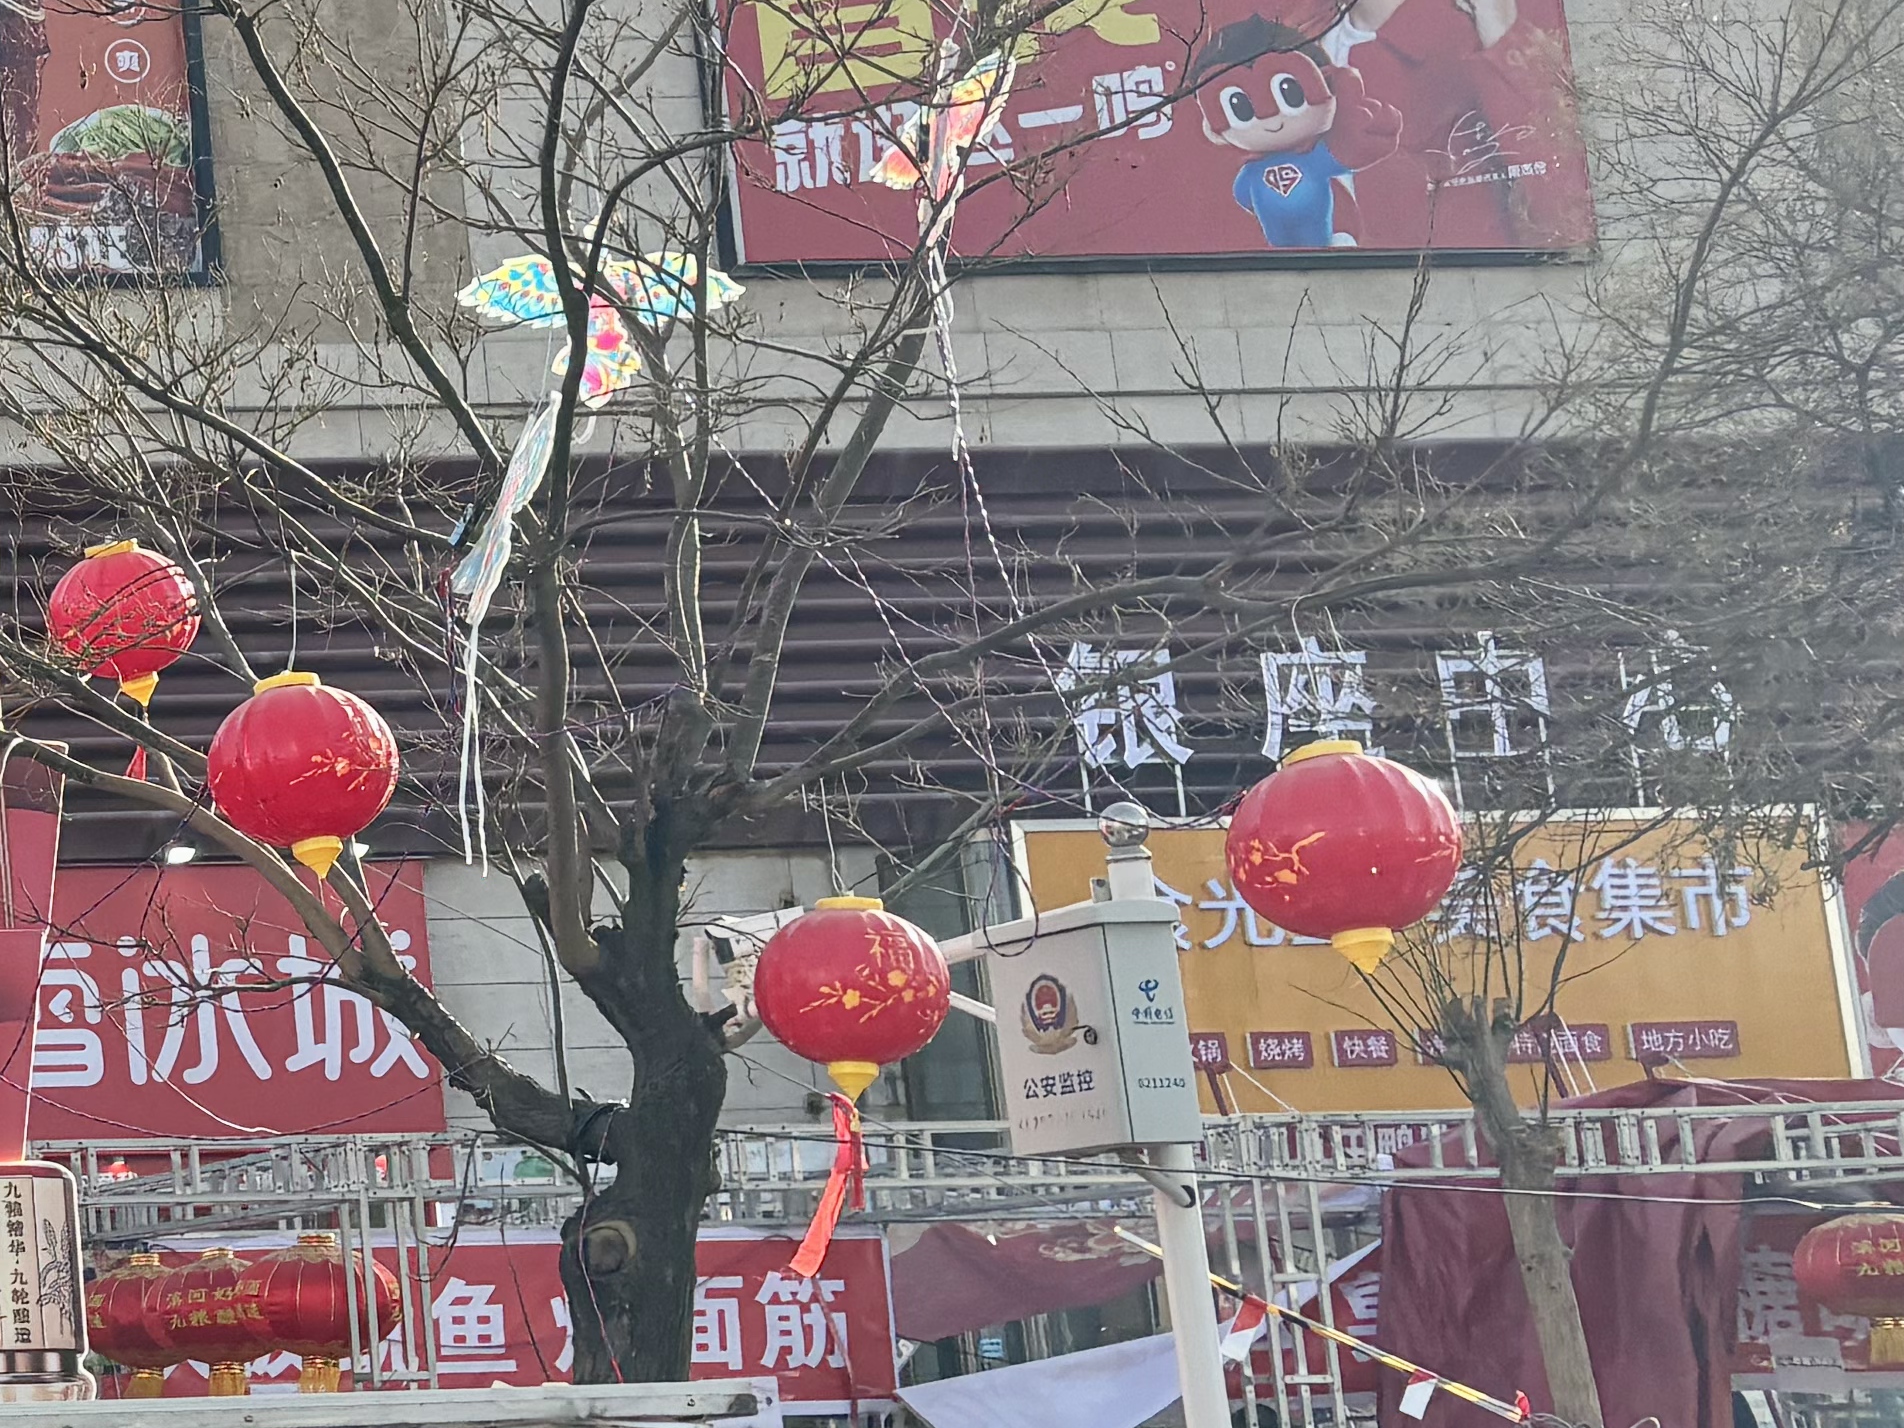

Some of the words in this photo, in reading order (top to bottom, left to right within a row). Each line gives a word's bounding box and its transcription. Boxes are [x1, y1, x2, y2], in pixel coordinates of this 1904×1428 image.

[1258, 1036, 1306, 1061] 烧烤
[1342, 1034, 1391, 1061] 快餐
[1641, 1027, 1734, 1053] 地方小吃
[1023, 1070, 1096, 1100] 公安监控
[550, 1270, 850, 1373] 面筋
